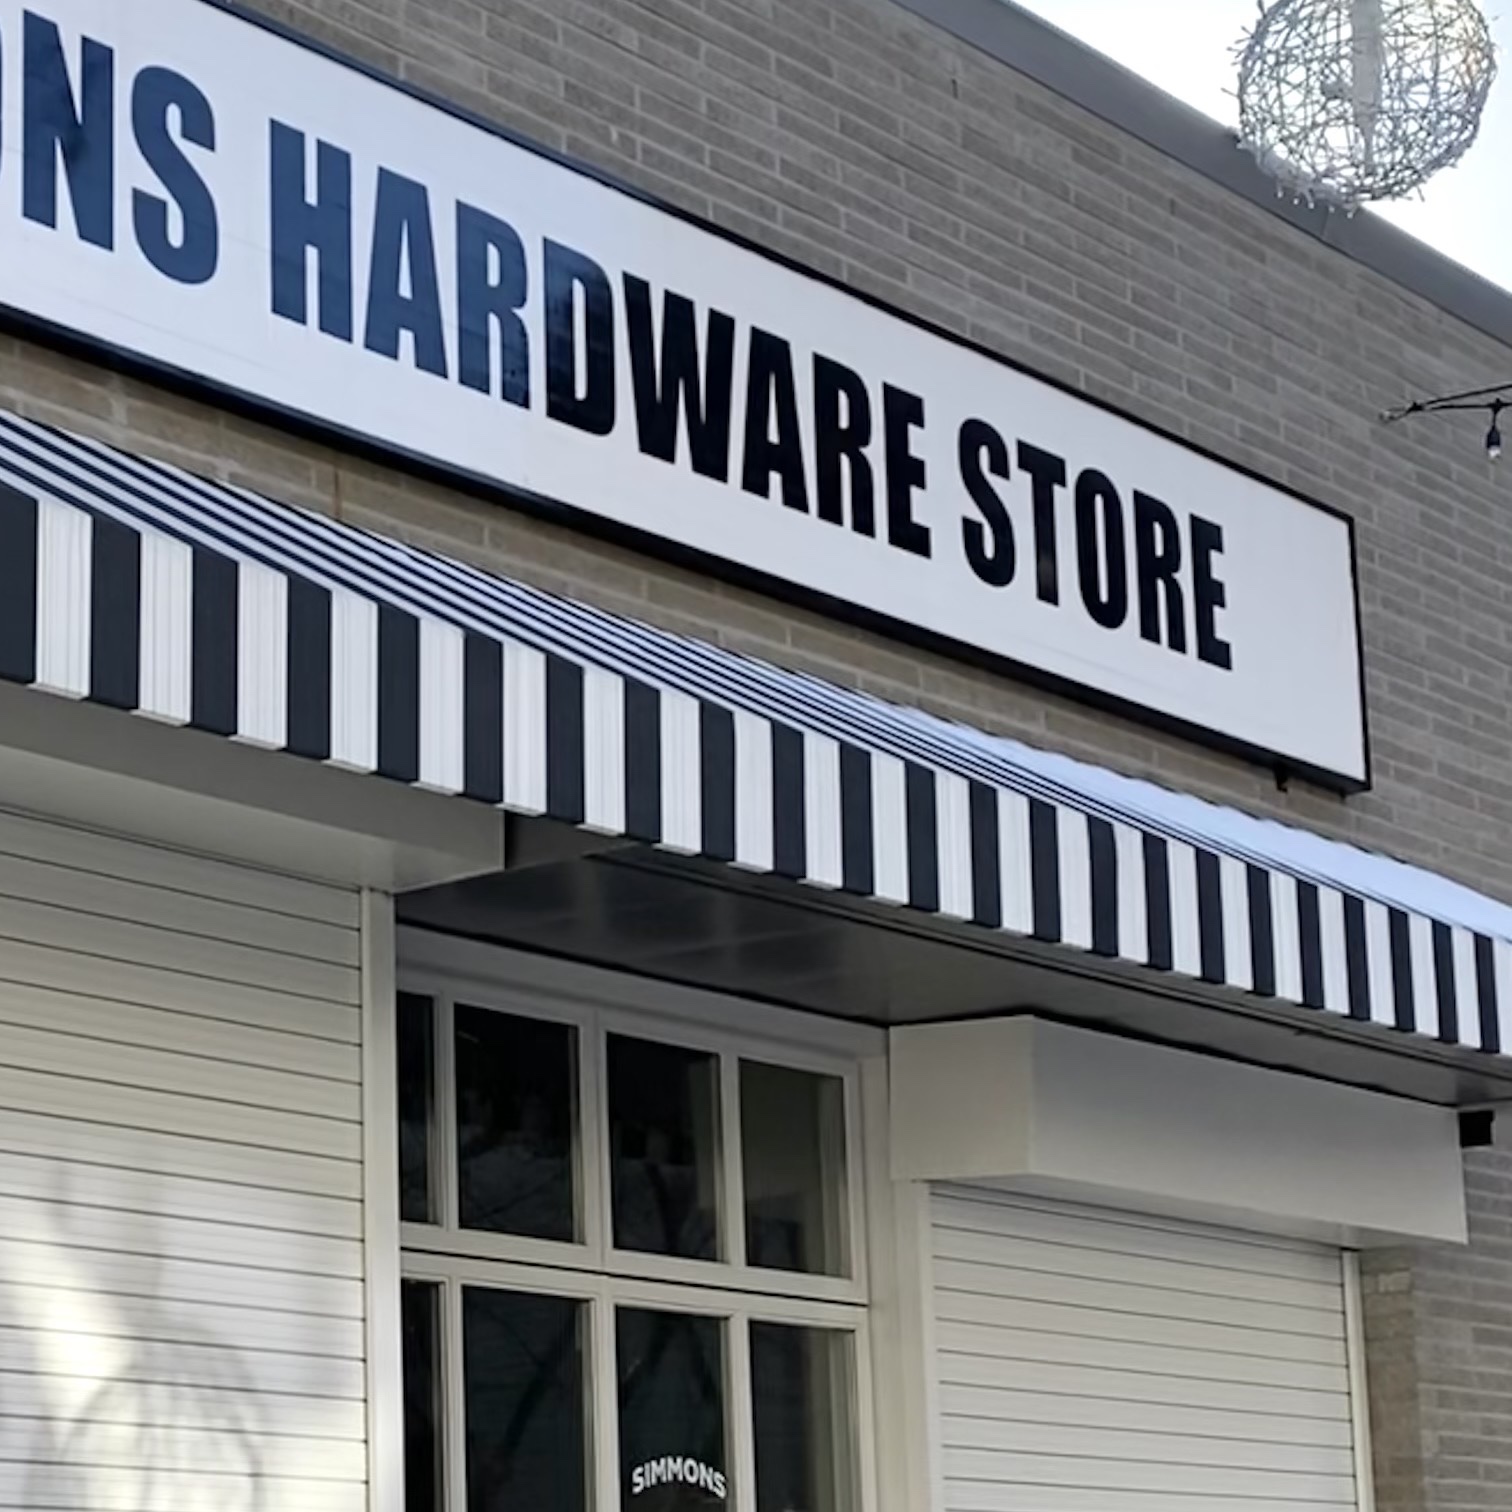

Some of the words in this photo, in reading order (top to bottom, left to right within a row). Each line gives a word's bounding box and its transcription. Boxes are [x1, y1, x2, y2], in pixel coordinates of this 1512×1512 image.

[269, 117, 932, 560] HARDWARE
[957, 417, 1232, 671] STORE
[631, 1456, 728, 1499] SIMMONS
